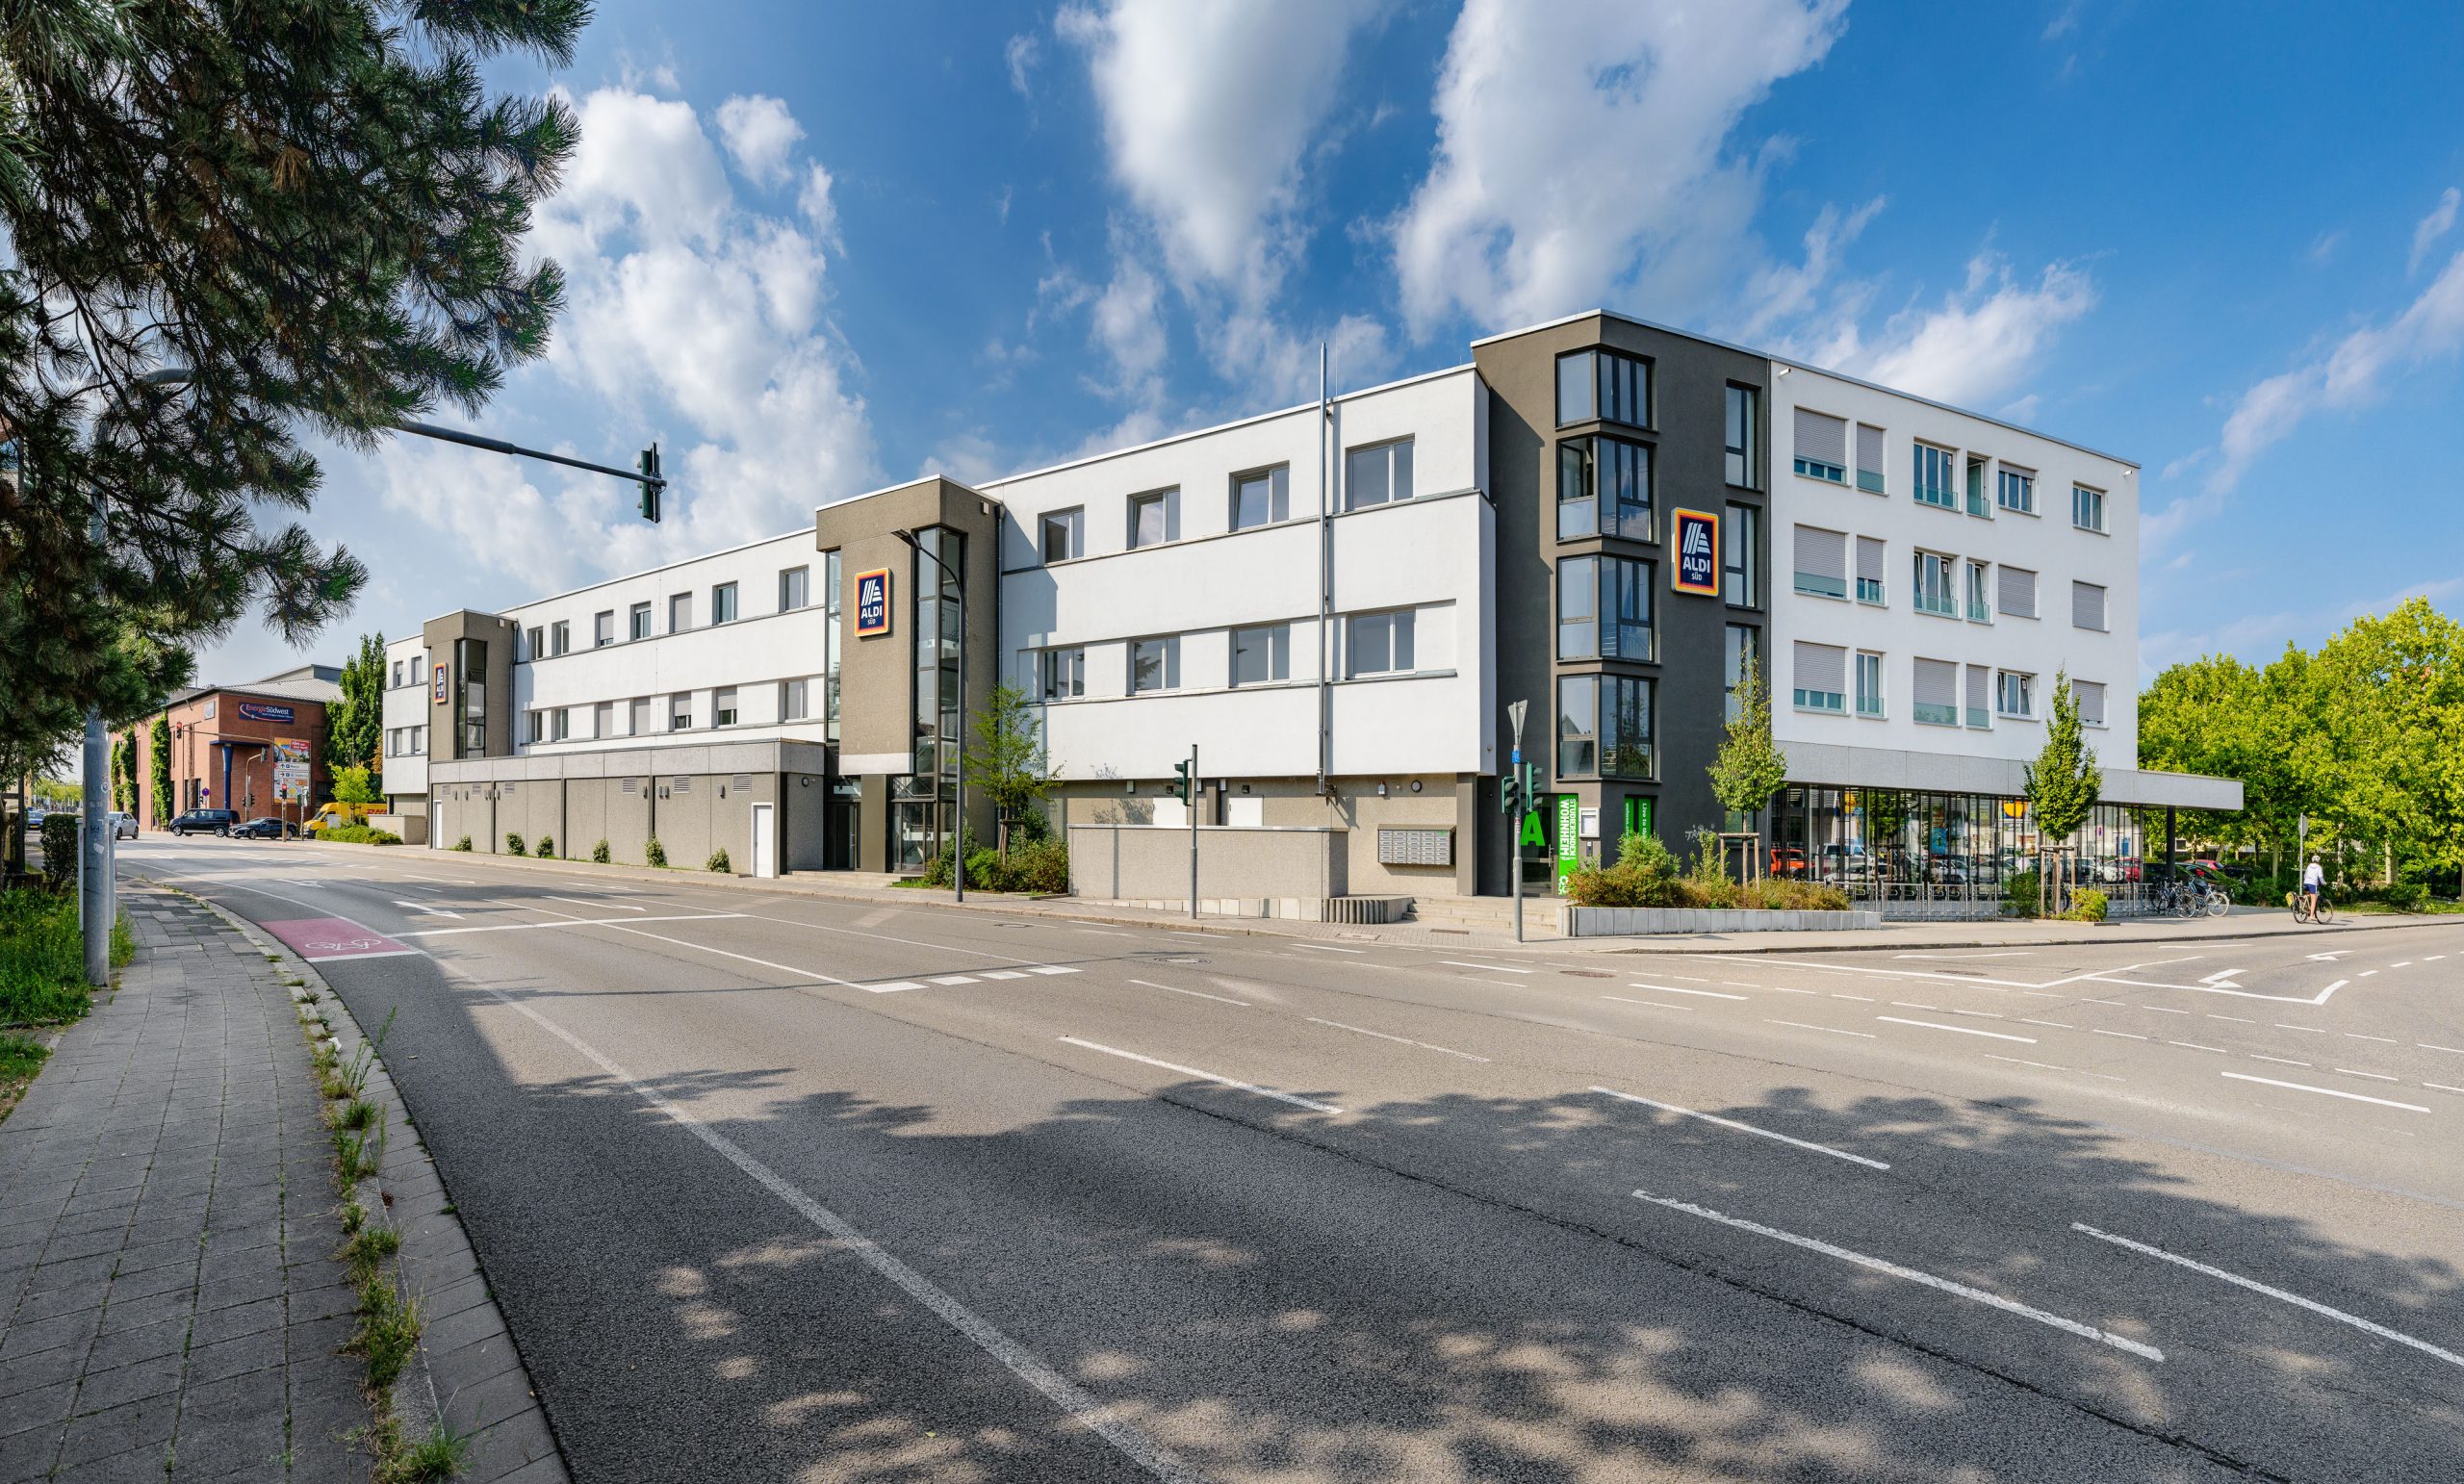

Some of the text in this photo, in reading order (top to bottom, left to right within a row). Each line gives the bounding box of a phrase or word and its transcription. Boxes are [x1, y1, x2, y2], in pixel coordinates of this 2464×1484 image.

[1682, 556, 1710, 574] ALDI
[1691, 572, 1703, 581] SÜD
[860, 604, 883, 619] ALDI
[1520, 810, 1546, 847] A
[1560, 798, 1570, 856] WOHNHEIM
